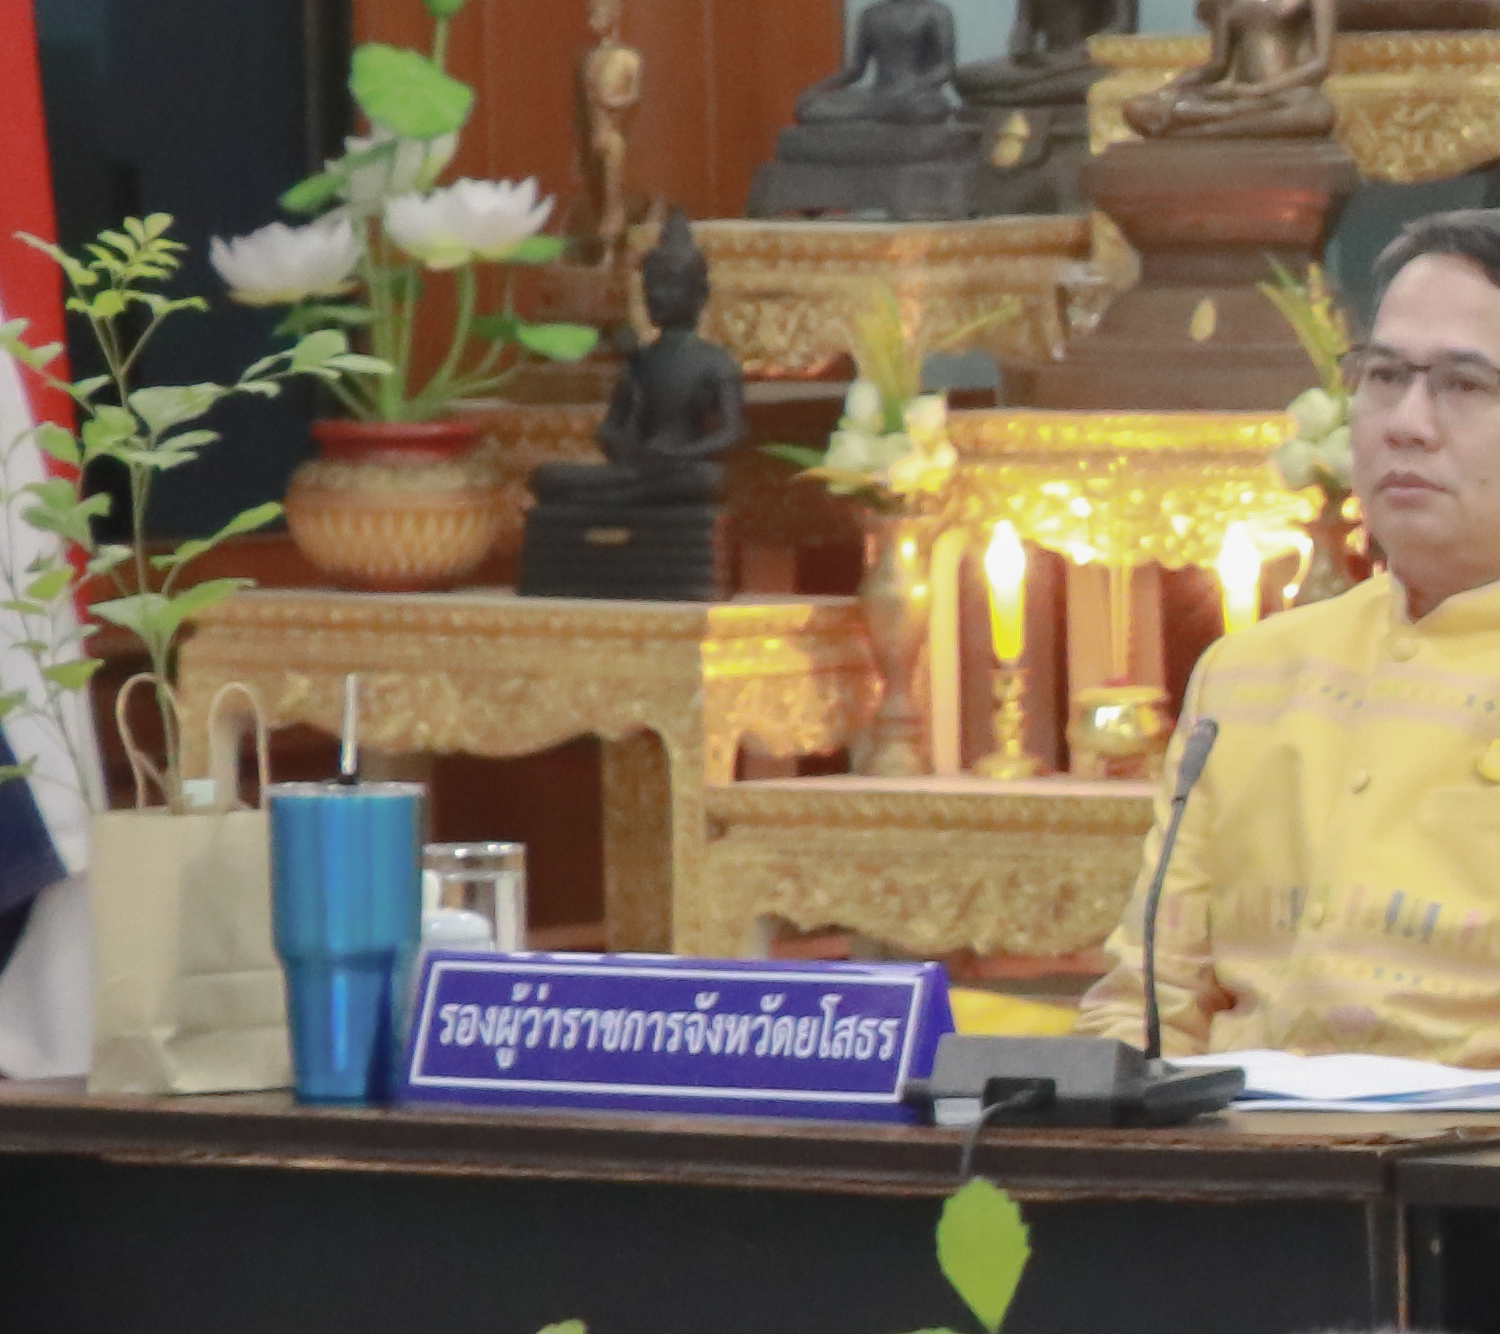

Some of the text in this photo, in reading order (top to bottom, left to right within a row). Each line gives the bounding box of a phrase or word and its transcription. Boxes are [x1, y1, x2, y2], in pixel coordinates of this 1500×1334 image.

[438, 982, 899, 1070] รองผู้ว่าราชการจังหวัดยโสธร
